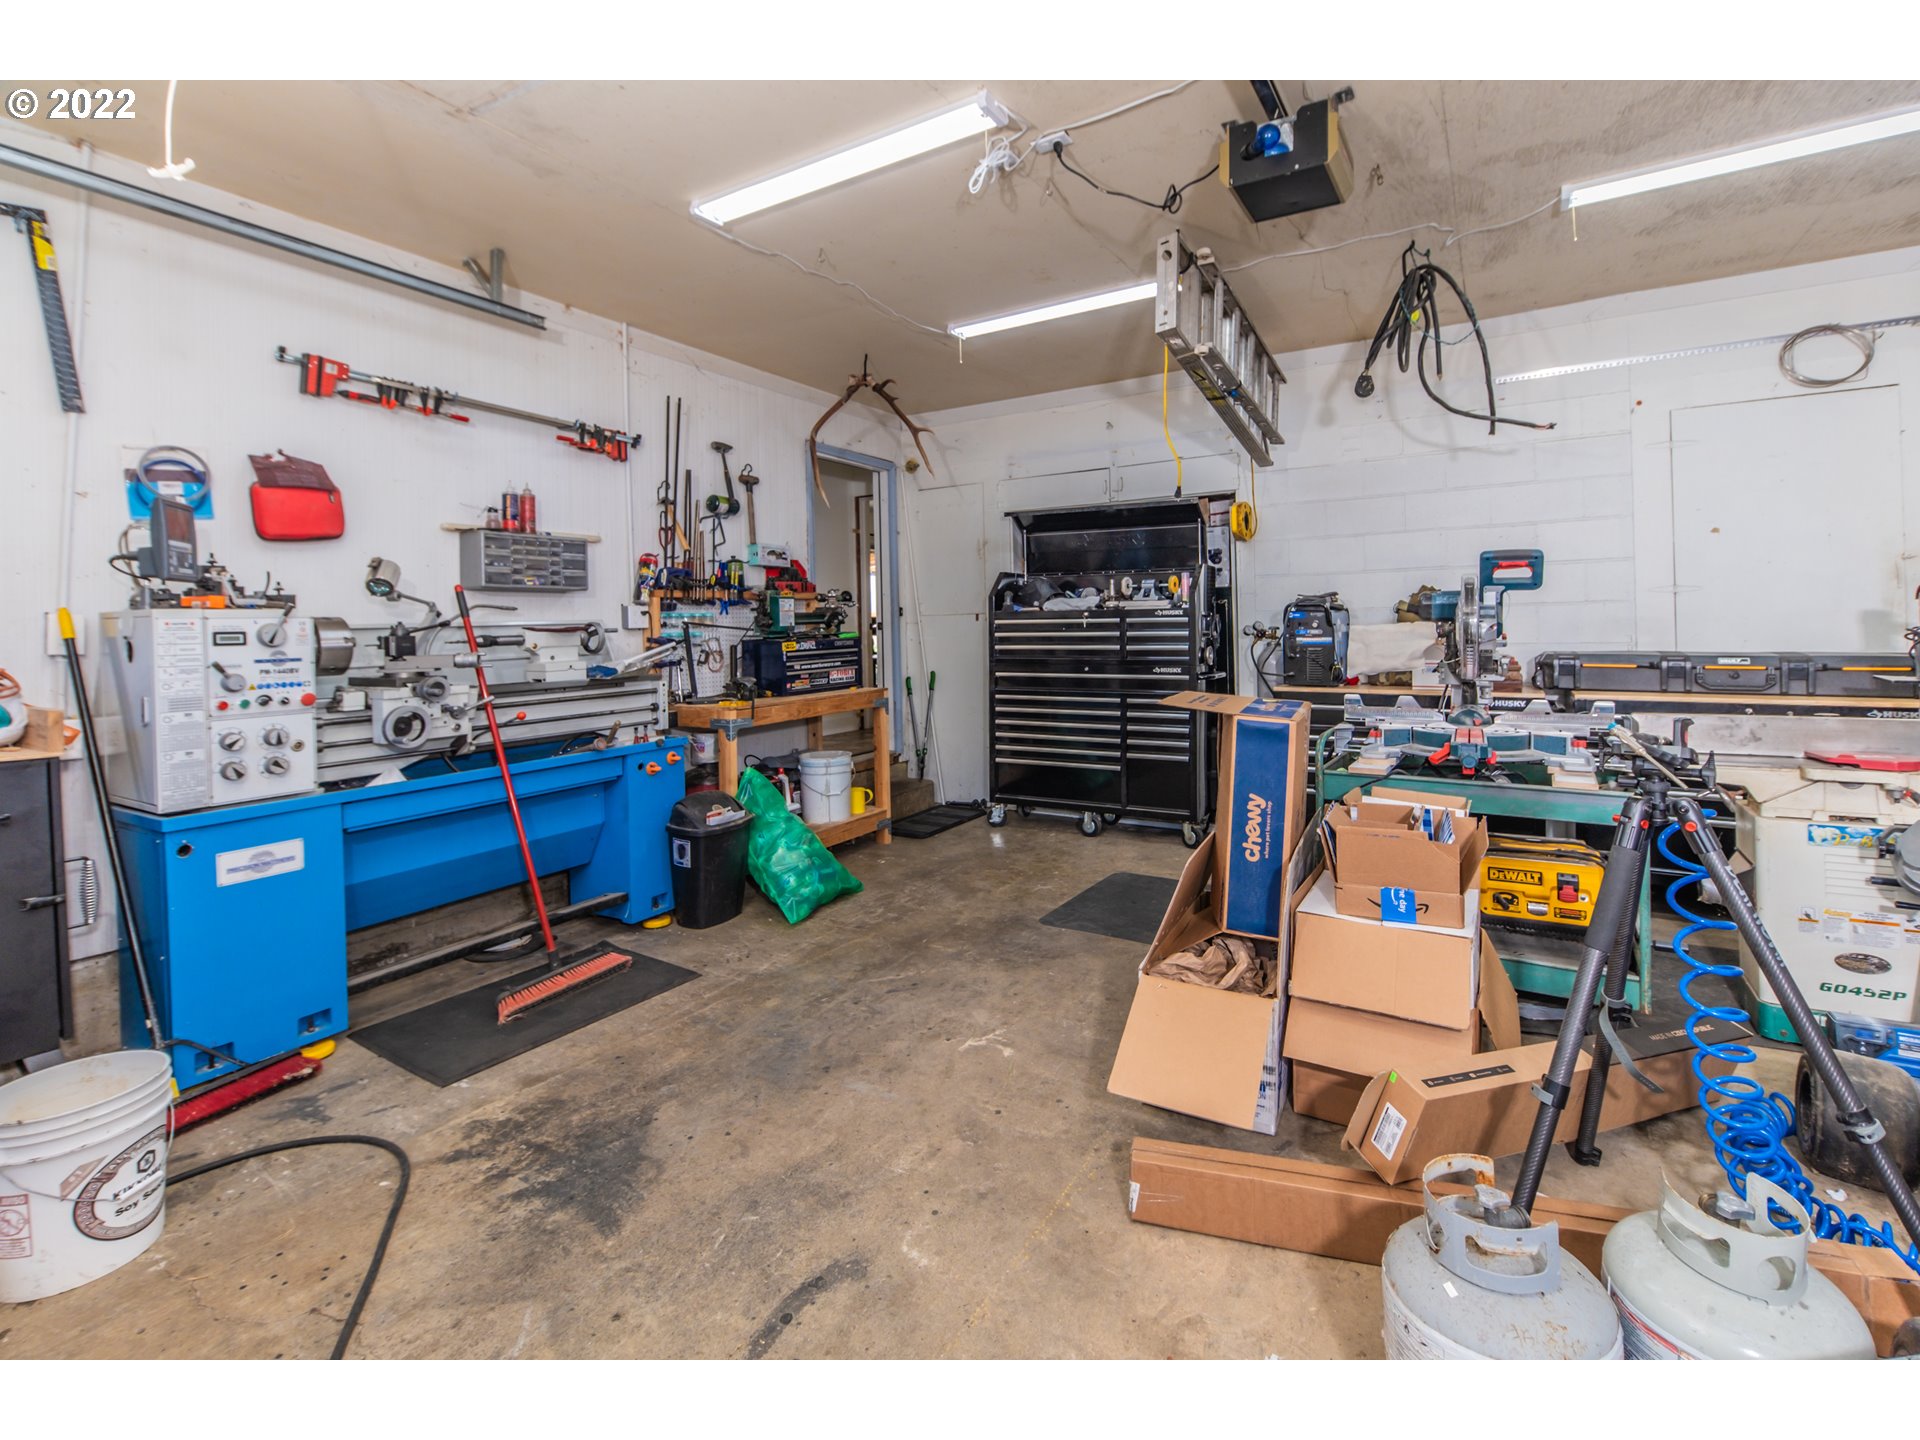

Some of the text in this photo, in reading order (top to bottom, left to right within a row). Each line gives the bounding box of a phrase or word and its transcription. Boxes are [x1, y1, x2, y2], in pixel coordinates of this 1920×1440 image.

[1494, 700, 1526, 708] HUSKY
[1882, 711, 1920, 719] HUSK
[1241, 793, 1267, 862] chewy
[1397, 899, 1408, 913] day
[114, 1201, 140, 1218] Soy
